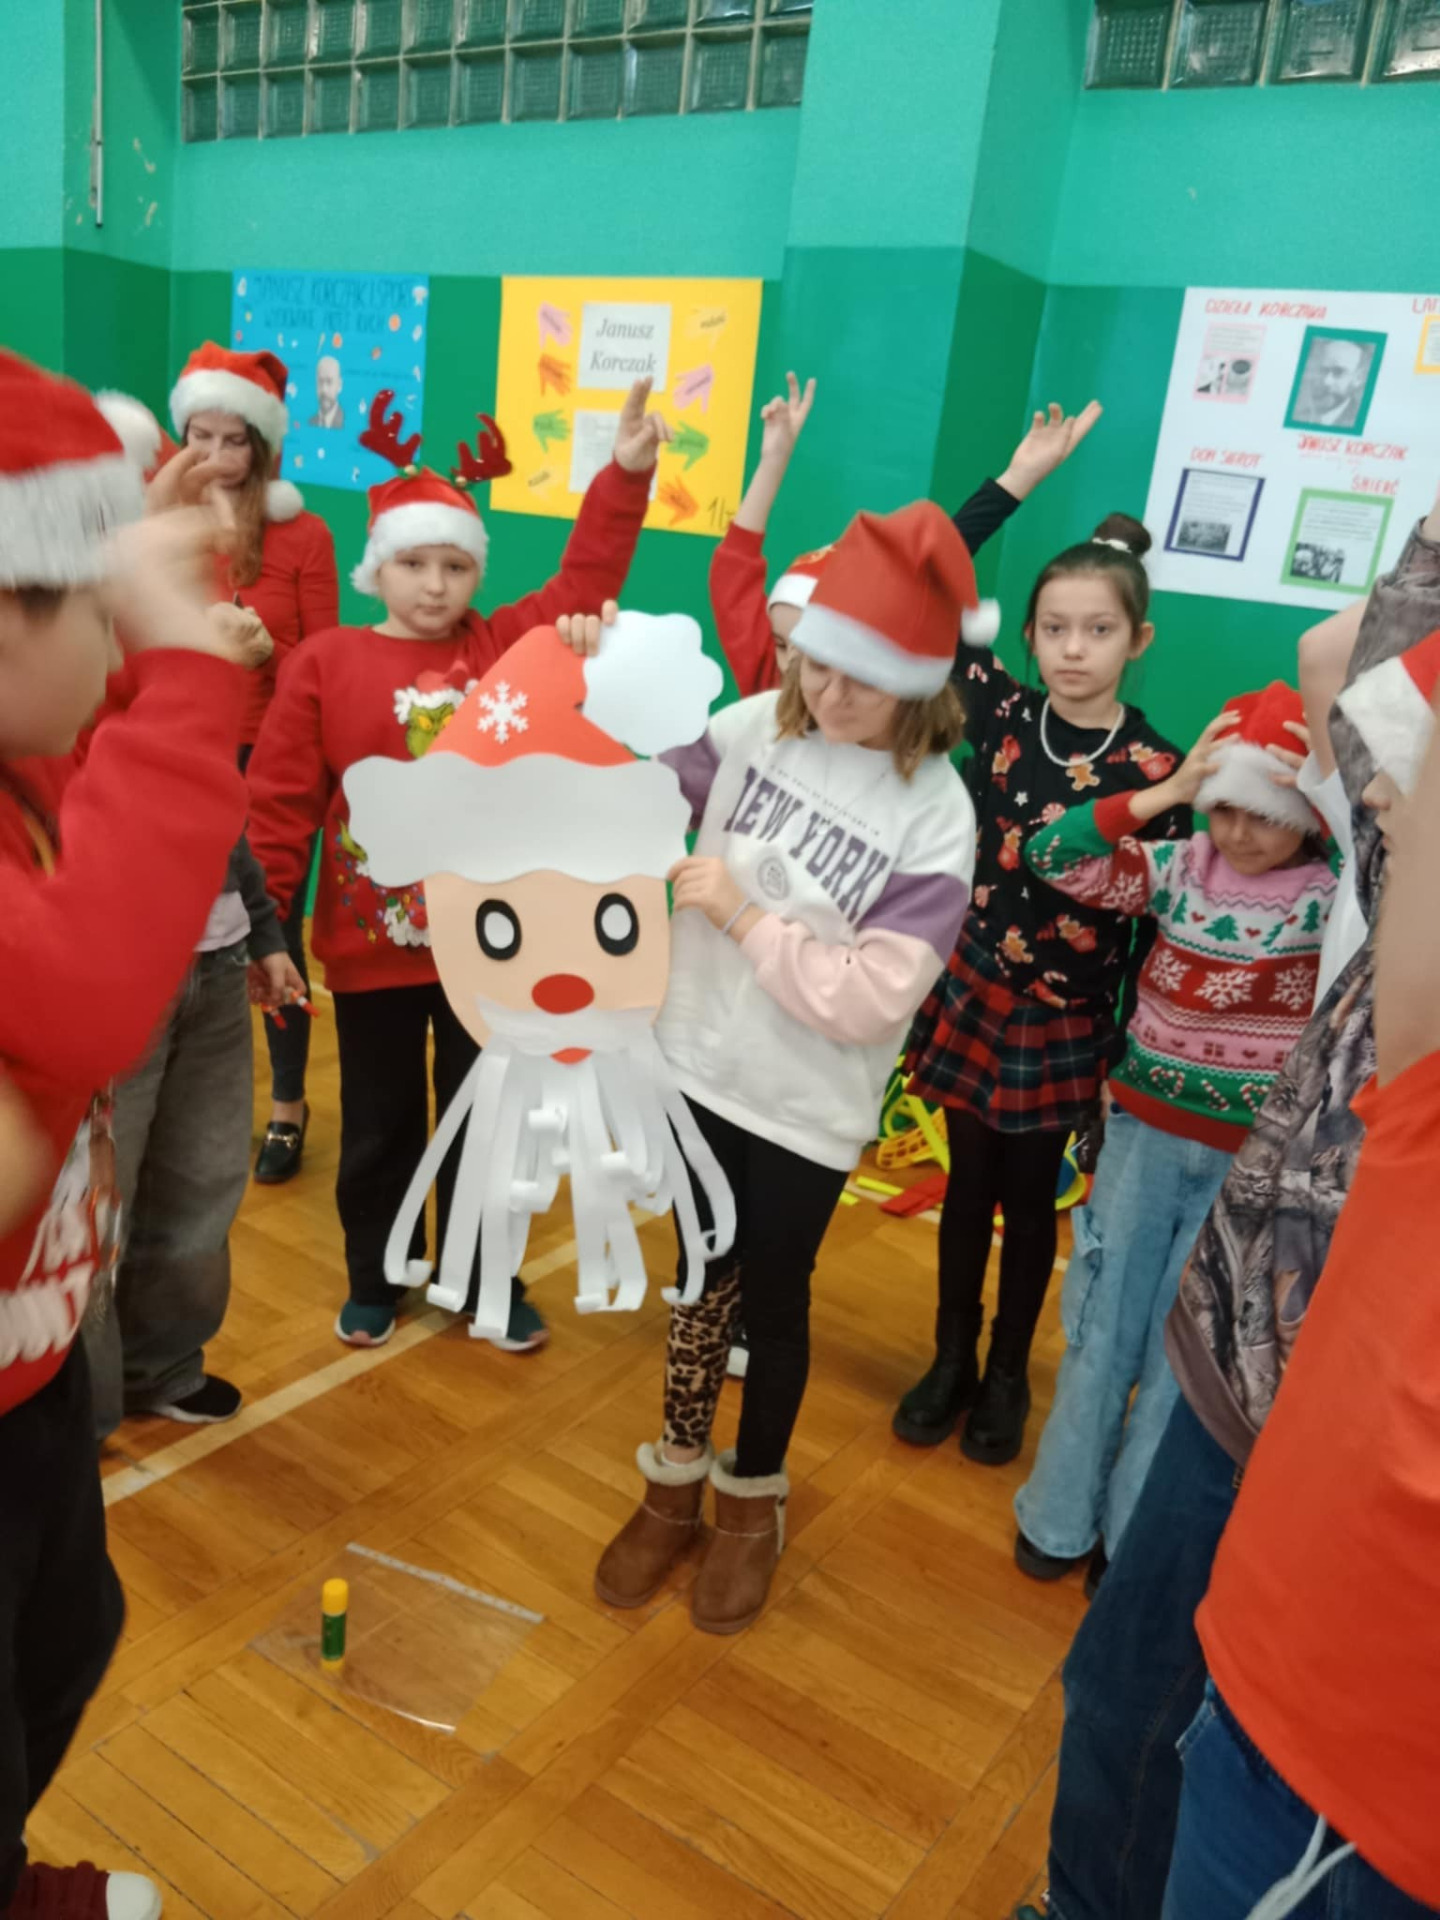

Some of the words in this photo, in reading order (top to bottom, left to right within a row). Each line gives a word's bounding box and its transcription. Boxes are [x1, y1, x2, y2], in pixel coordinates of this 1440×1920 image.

[596, 318, 654, 339] Janusz
[590, 350, 657, 373] Korczak
[1345, 440, 1408, 460] KORCZAK
[788, 811, 889, 924] YORK
